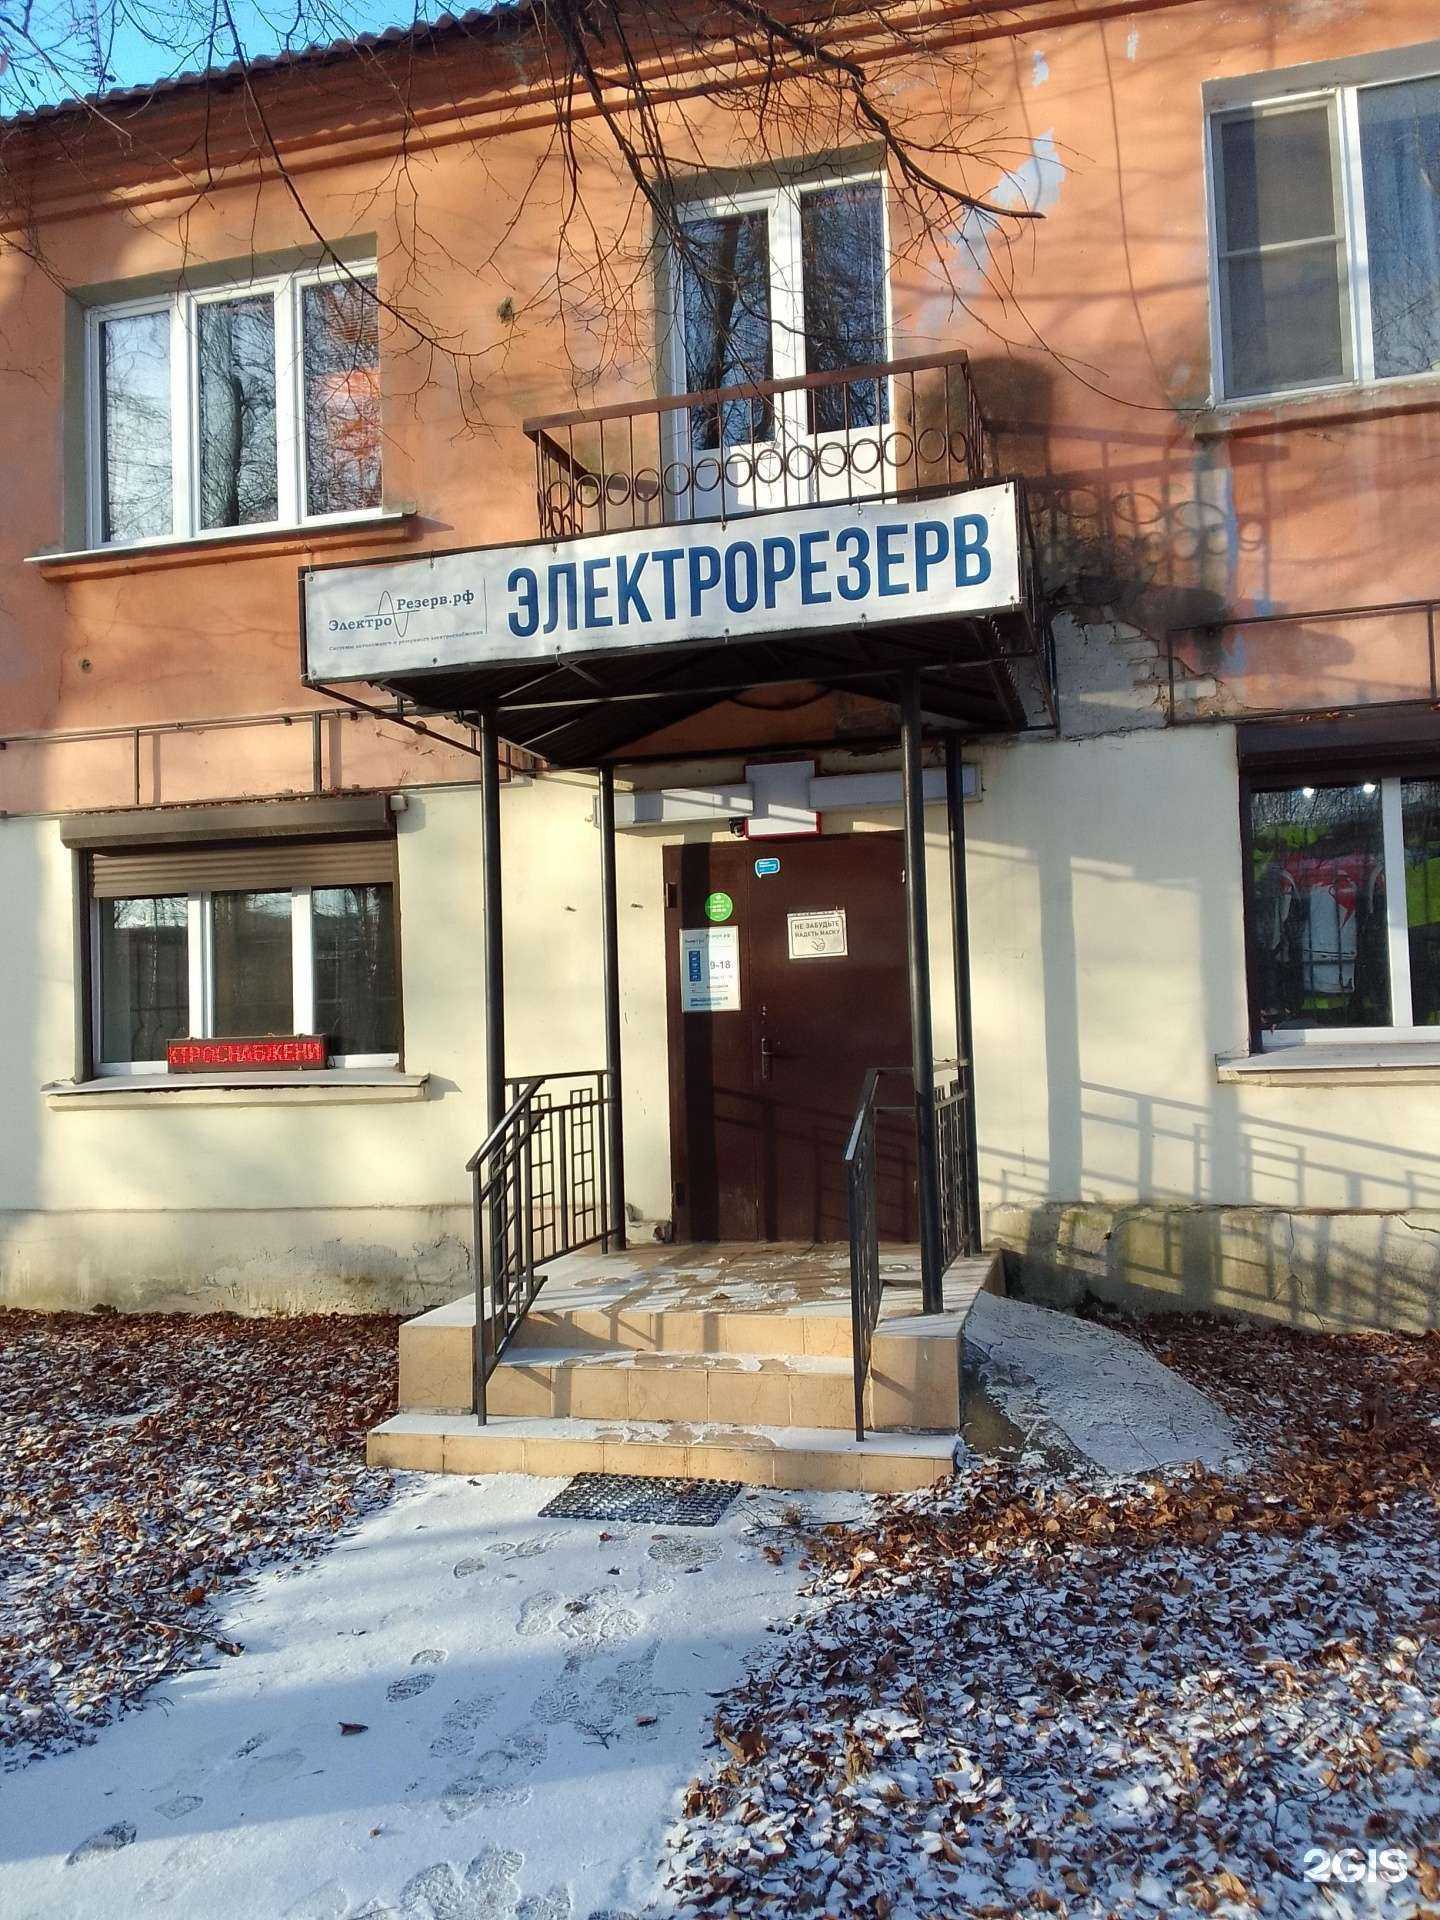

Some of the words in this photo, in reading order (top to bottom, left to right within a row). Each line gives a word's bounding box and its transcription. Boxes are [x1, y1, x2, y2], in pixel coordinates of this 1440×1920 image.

[507, 513, 992, 638] ЭЛЕКТРОРЕЗЕРВ
[328, 615, 393, 632] Электро
[396, 589, 475, 611] Резерв.рф
[794, 929, 819, 938] НАДЕТЬ
[820, 928, 840, 936] МАСКУ
[805, 920, 840, 930] ЗАБУДЬТЕ
